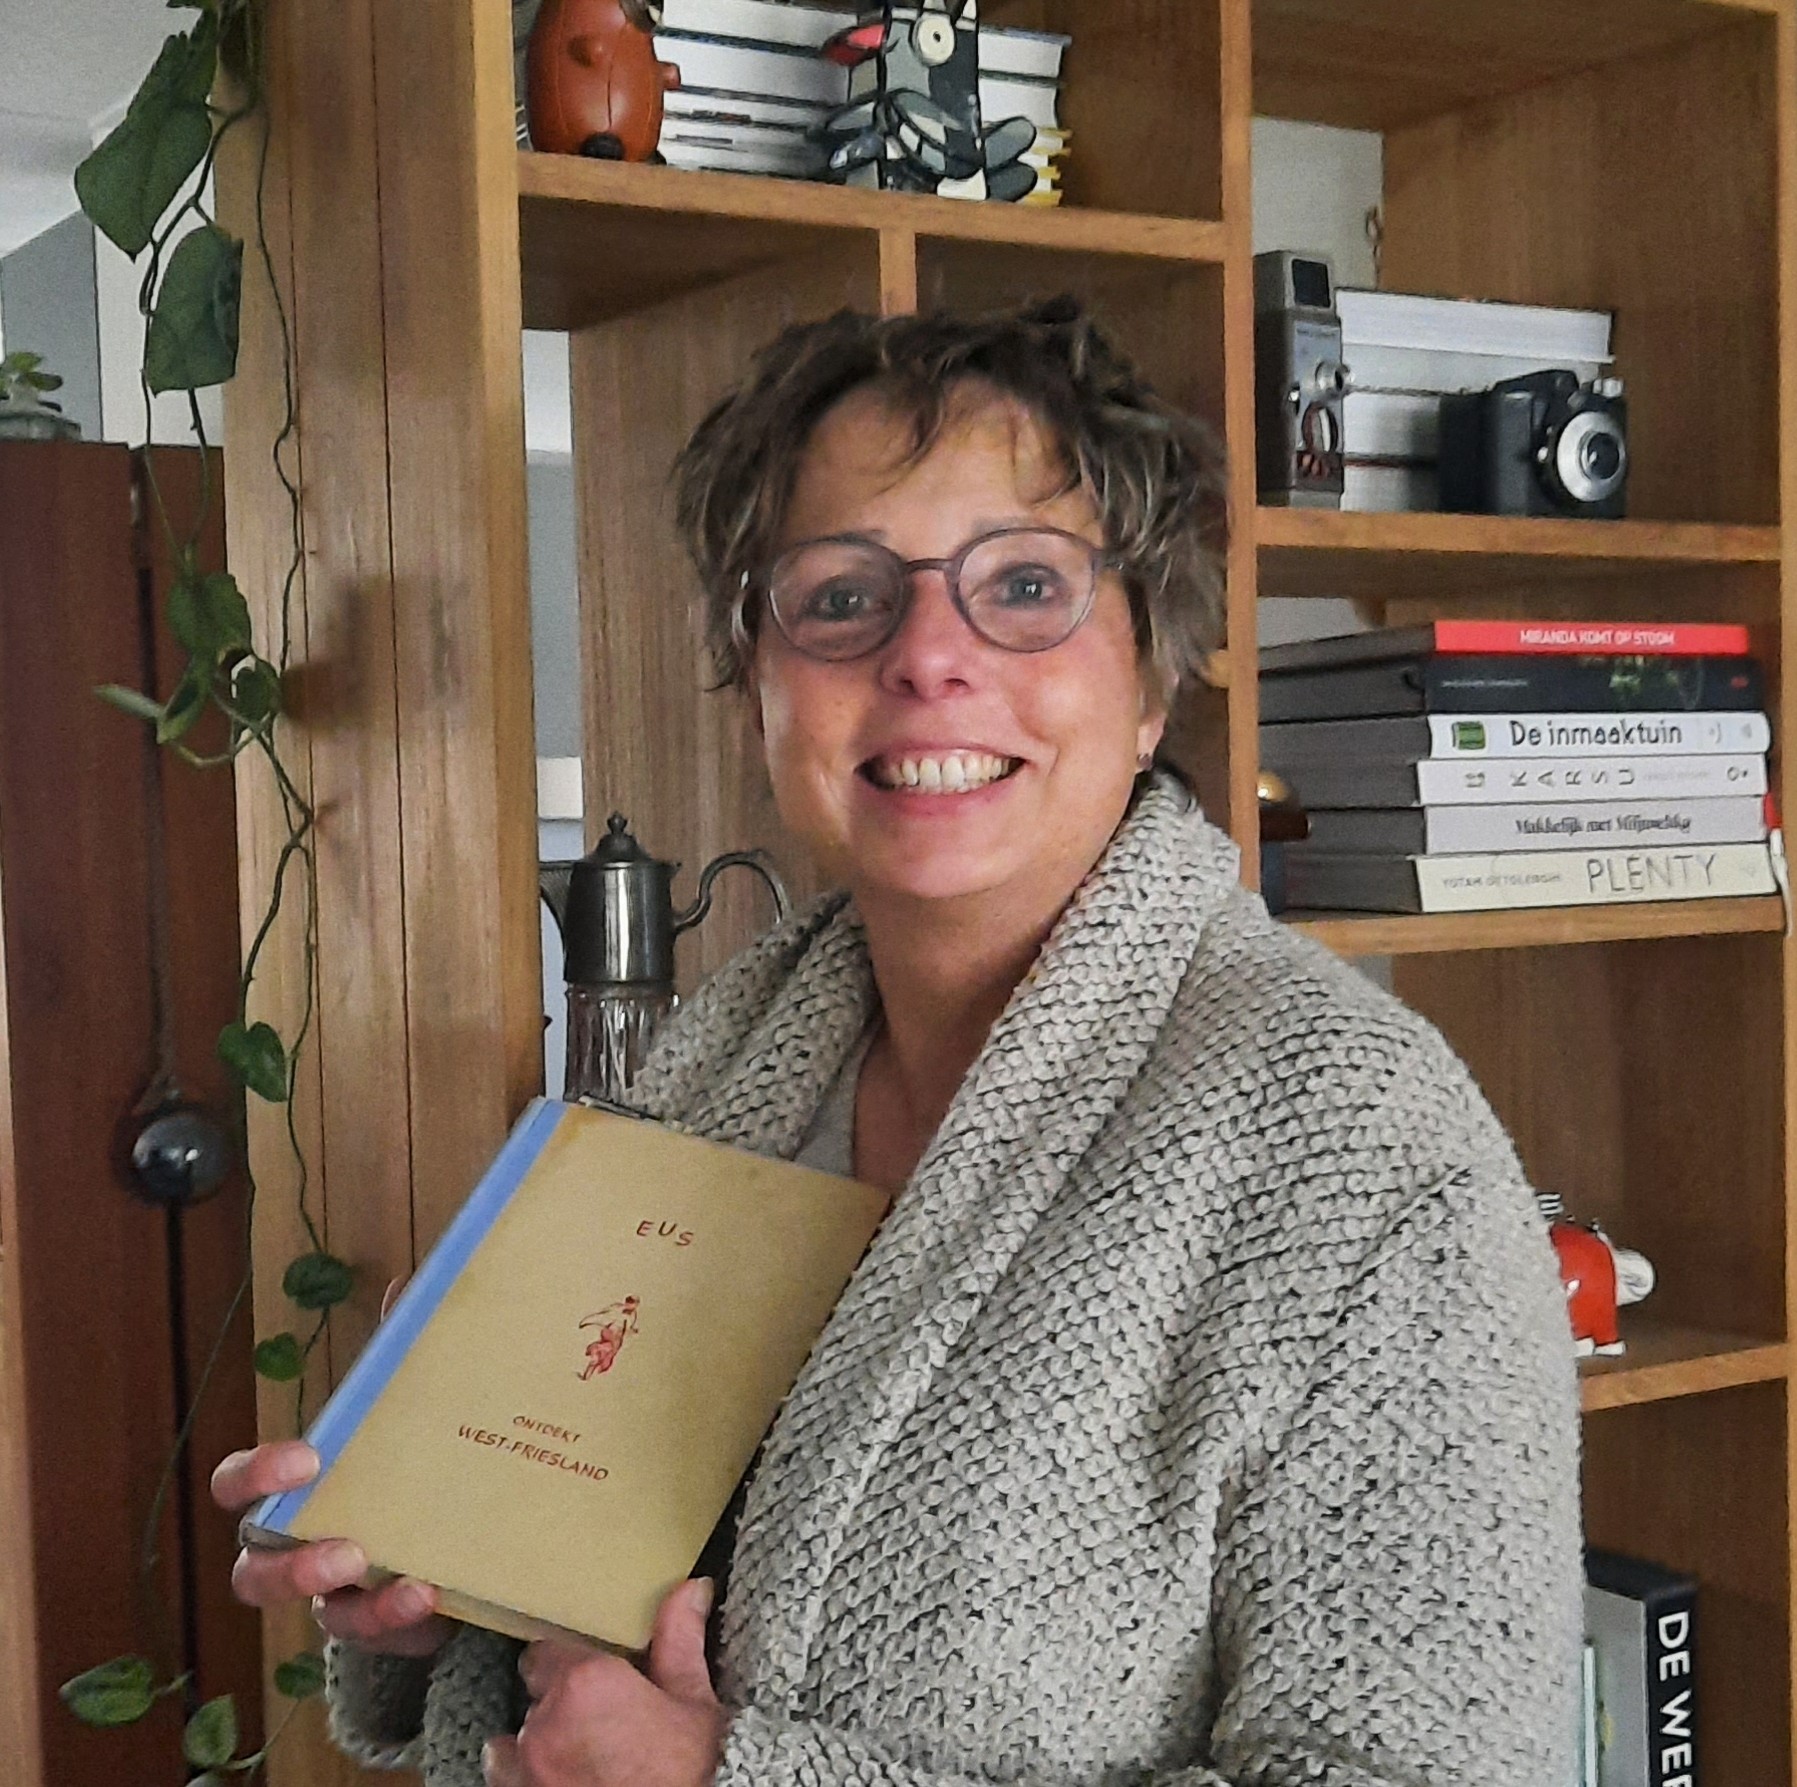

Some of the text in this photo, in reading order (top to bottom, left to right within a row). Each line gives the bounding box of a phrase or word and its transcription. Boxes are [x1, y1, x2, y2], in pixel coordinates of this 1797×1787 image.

[1519, 629, 1577, 645] MIRANDA
[1510, 719, 1684, 746] De inmaaktuin
[1586, 853, 1717, 893] PLENTY
[636, 1219, 694, 1247] EUS
[512, 1415, 582, 1444] ONTDEKT
[457, 1425, 610, 1482] WEST-FRIESLAND
[1658, 1611, 1690, 1681] DE
